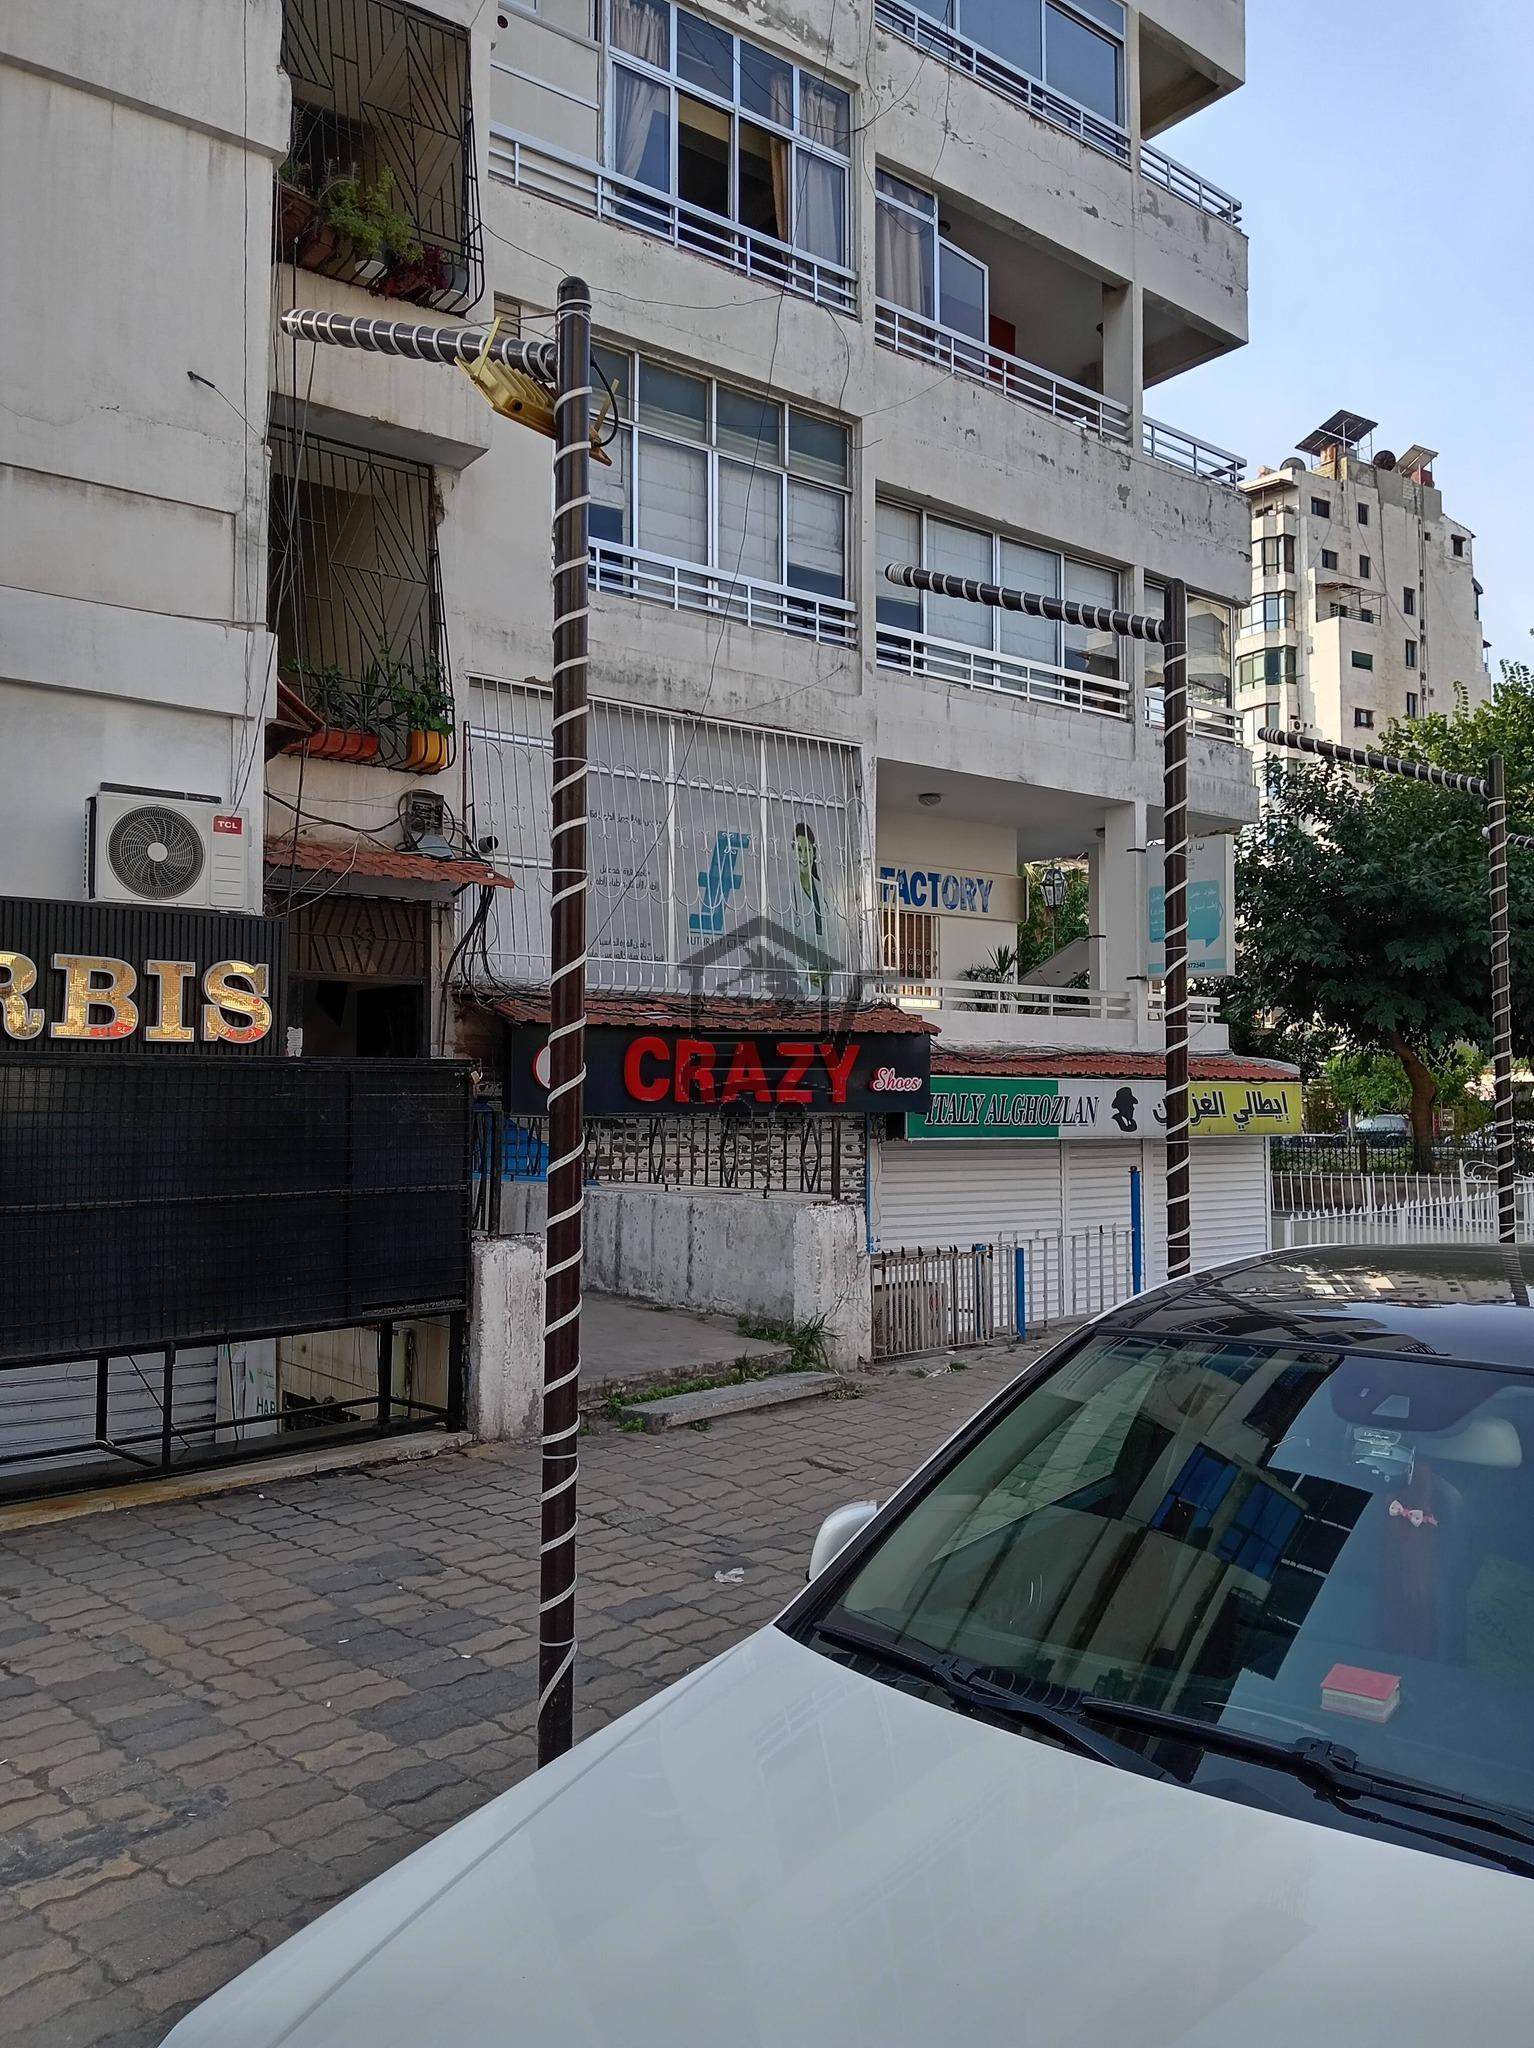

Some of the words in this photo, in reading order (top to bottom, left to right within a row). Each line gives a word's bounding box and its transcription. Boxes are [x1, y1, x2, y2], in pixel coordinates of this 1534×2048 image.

[217, 820, 238, 829] TCL
[880, 866, 994, 913] FACTORY
[624, 1036, 860, 1104] CRAZY
[872, 1067, 923, 1092] Shoes
[924, 1092, 986, 1126] ITALY
[984, 1093, 1099, 1127] ALGHOZLAN
[1152, 1090, 1227, 1126] الغزن
